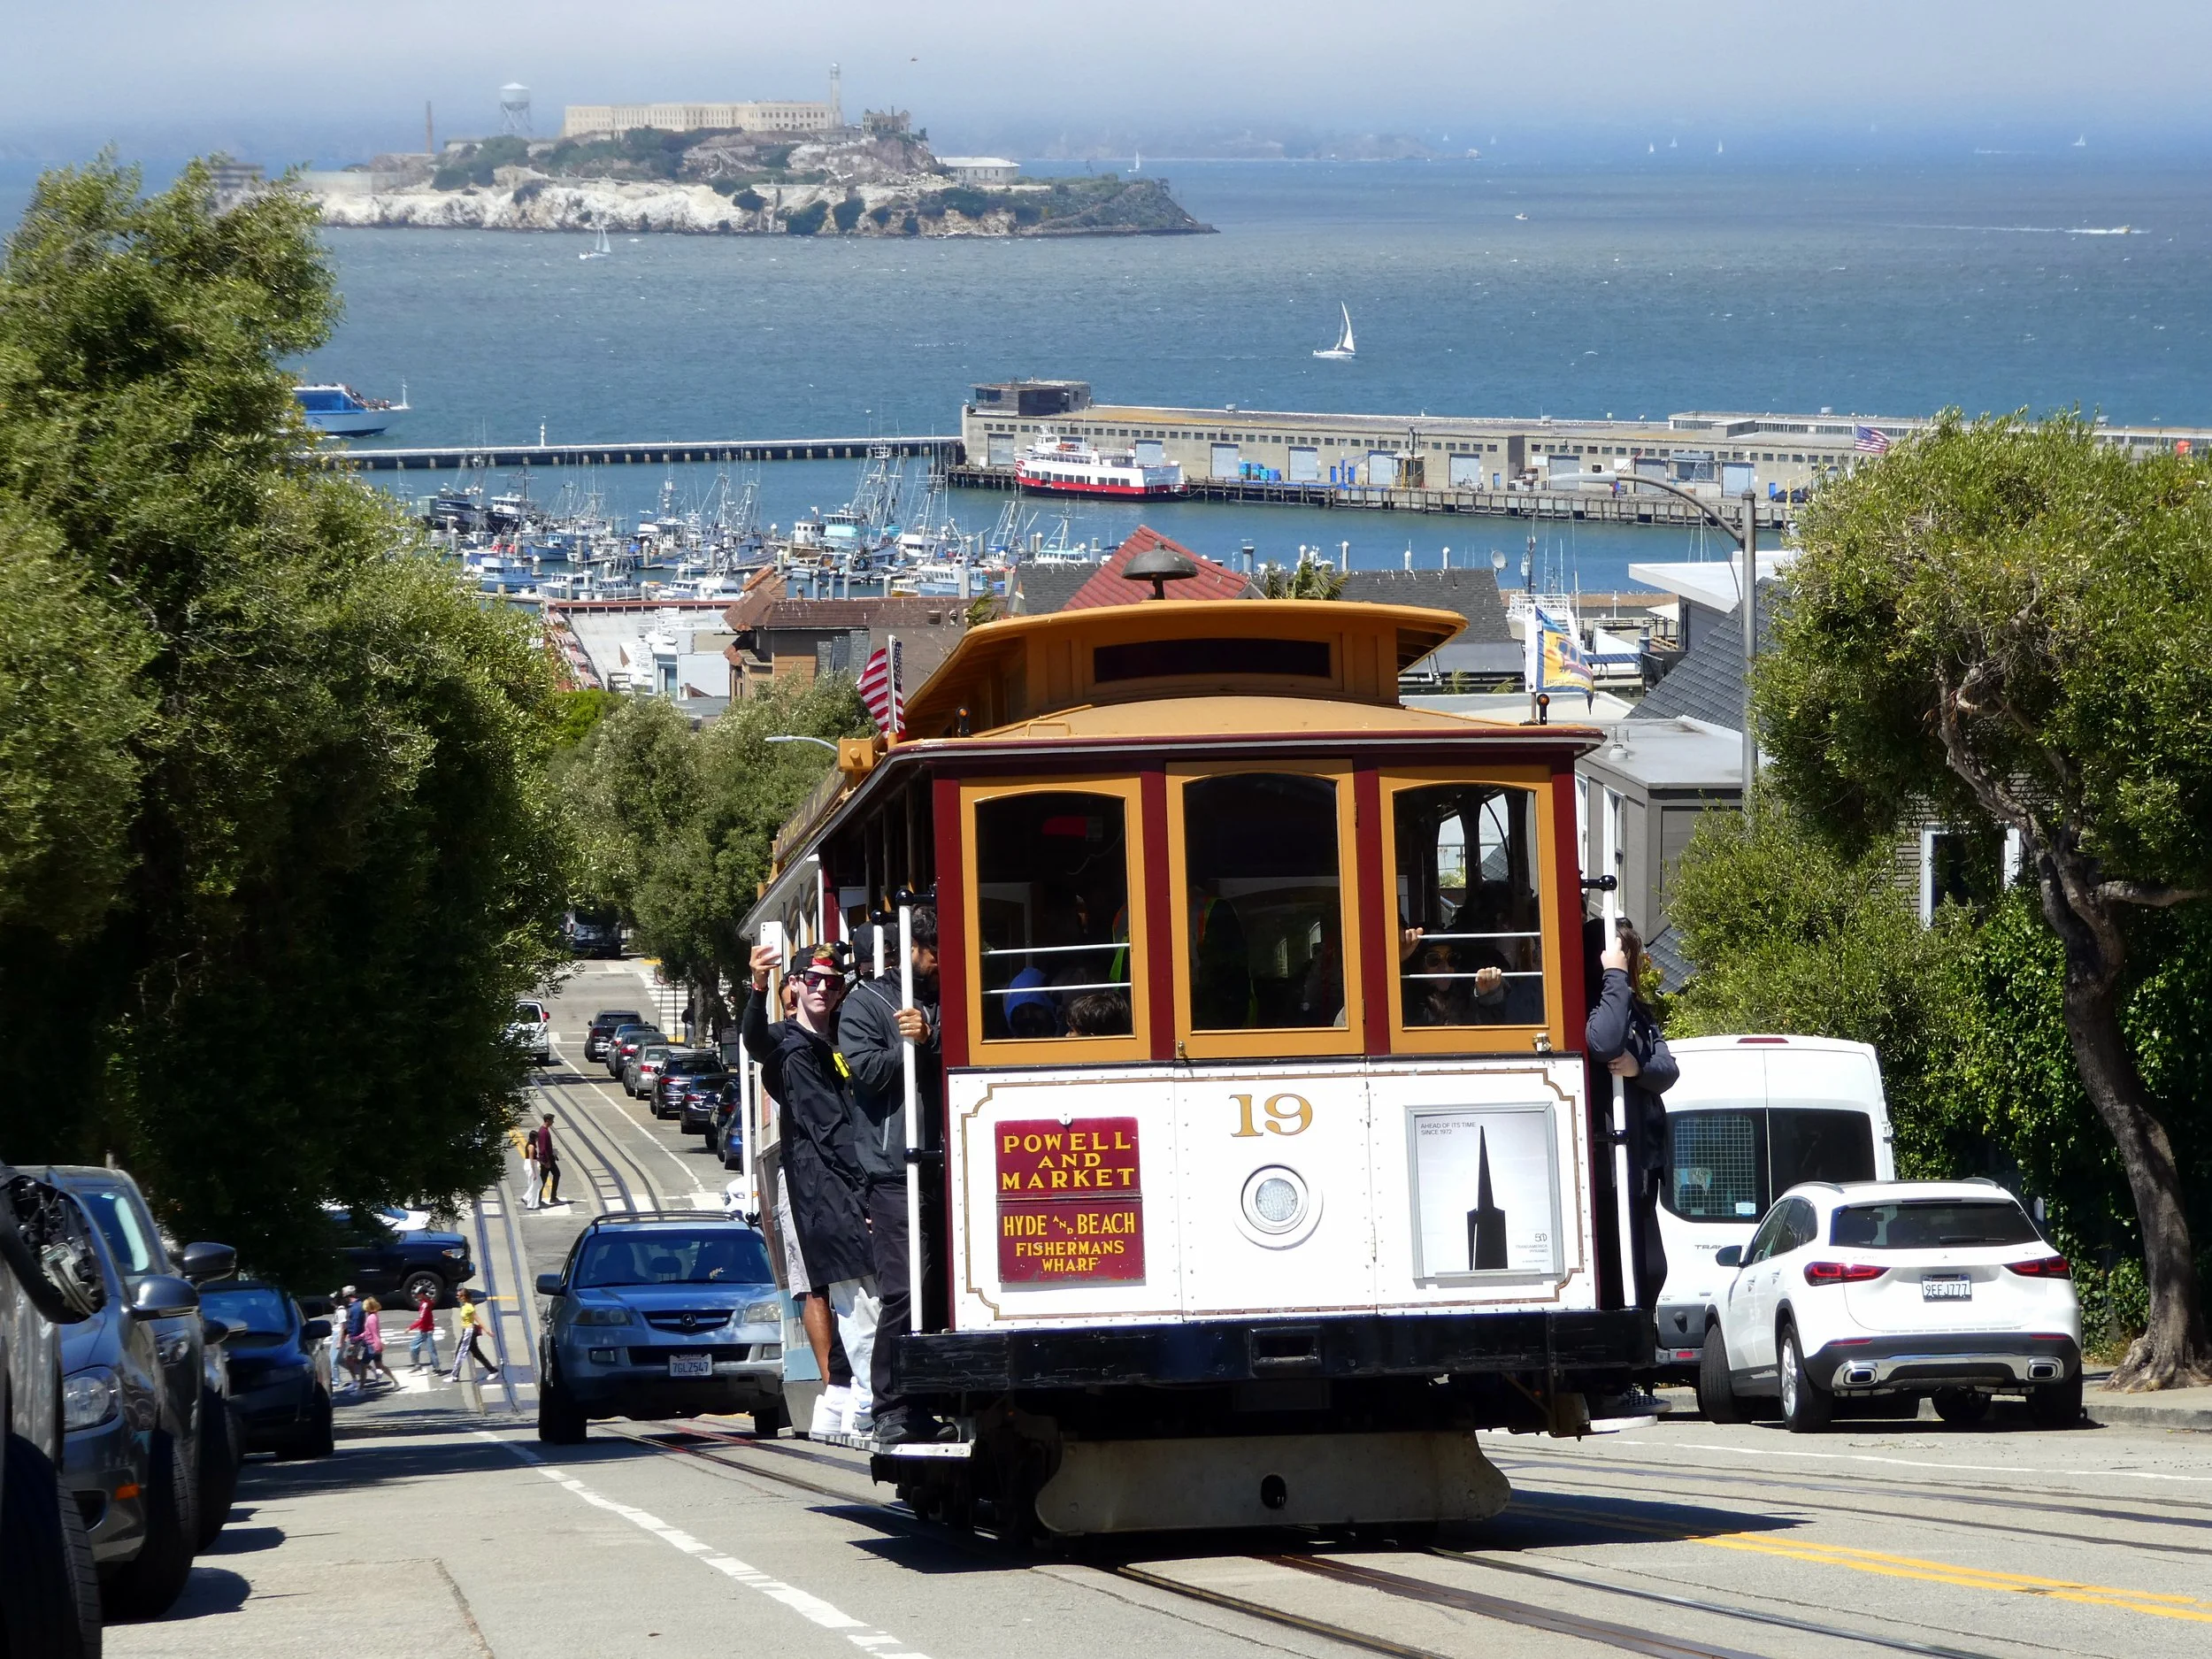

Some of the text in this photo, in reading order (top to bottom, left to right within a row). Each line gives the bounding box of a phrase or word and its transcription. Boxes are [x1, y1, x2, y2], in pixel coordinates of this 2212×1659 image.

[1228, 1093, 1313, 1137] 19
[1003, 1132, 1131, 1154] POWELL
[1038, 1152, 1102, 1169] AND
[1002, 1168, 1135, 1190] MARKET
[1003, 1212, 1135, 1237] HYDE AND BEACH
[1016, 1240, 1125, 1257] FISHERMANS
[1042, 1257, 1099, 1272] WHARF
[672, 1362, 709, 1373] 7GLZ547
